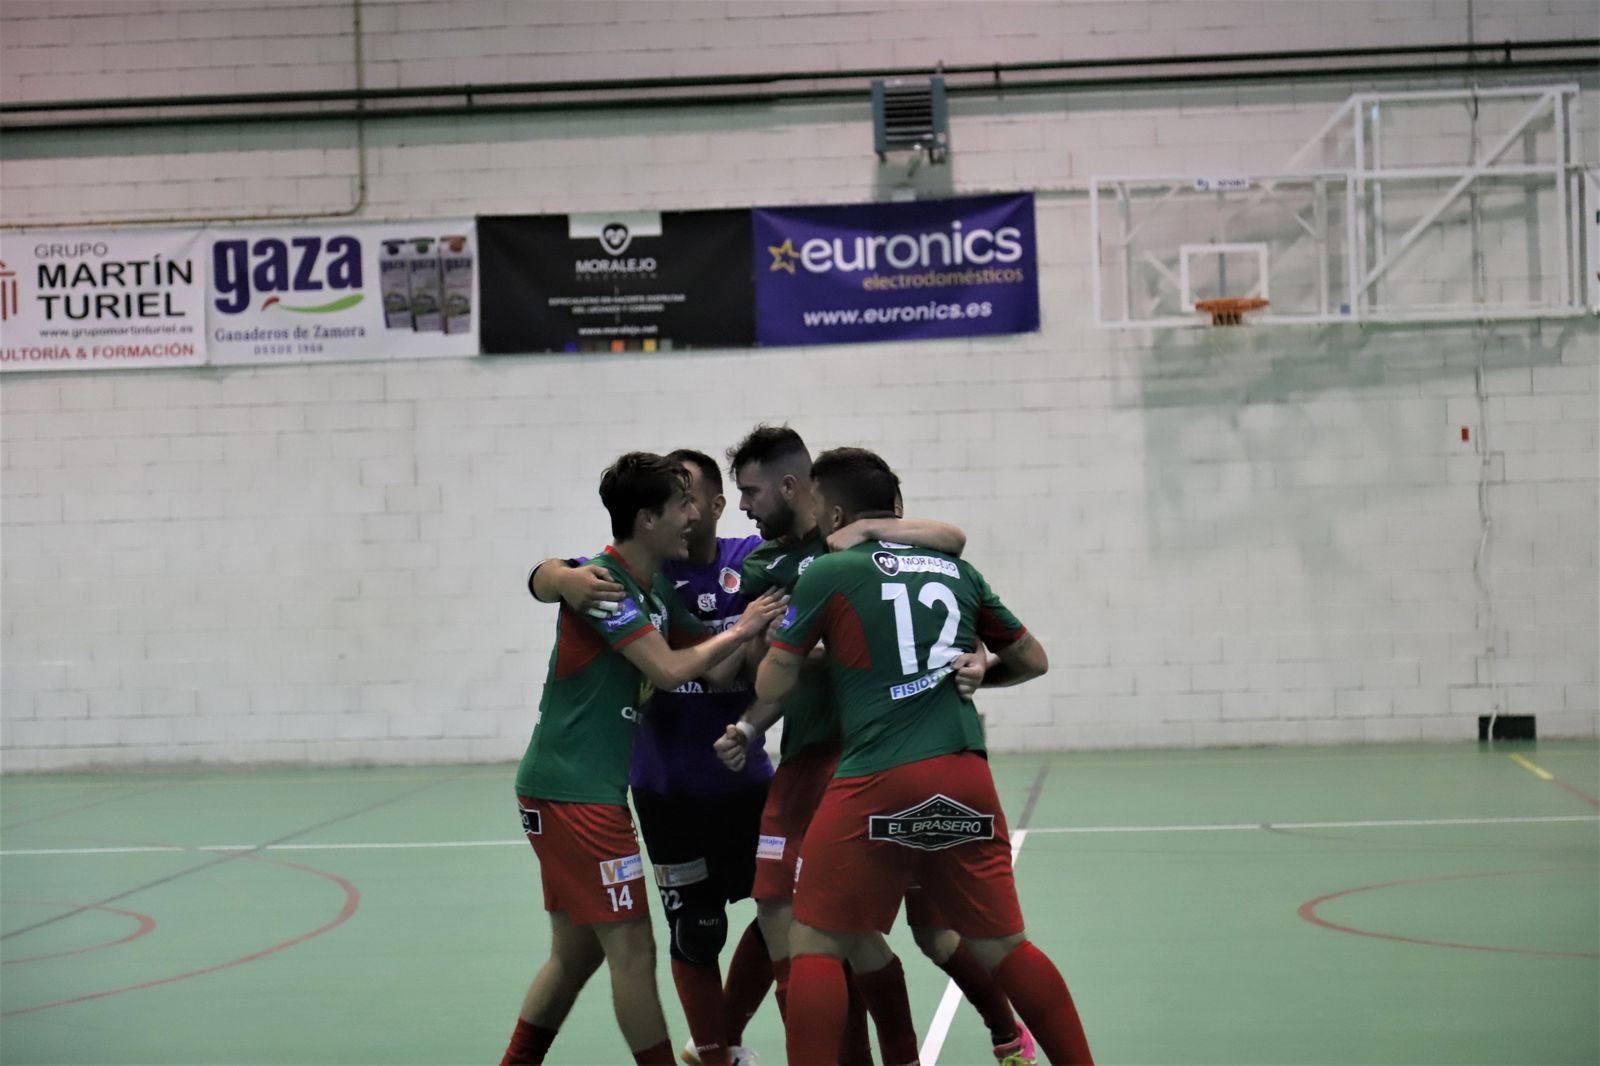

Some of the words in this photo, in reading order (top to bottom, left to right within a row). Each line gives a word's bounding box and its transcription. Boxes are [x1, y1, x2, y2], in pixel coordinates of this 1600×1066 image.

[34, 242, 108, 259] GRUPO
[800, 220, 1022, 273] euronics
[38, 254, 192, 289] MARTÍN
[213, 236, 364, 315] gaza
[575, 257, 657, 274] MORALEJO
[862, 267, 1024, 291] electrodomésticos
[37, 292, 185, 320] TURIEL
[803, 300, 992, 326] www.euronics.es
[39, 325, 193, 338] www.grupomartinturiel.es
[214, 327, 290, 343] Ganaderos
[292, 325, 309, 339] de
[312, 323, 367, 339] Zamora
[92, 342, 194, 359] FORMACIÓN
[901, 557, 957, 573] MORALEJO
[881, 581, 964, 676] 12
[888, 822, 907, 835] EL
[911, 820, 982, 833] BRASERO
[607, 885, 634, 912] 14
